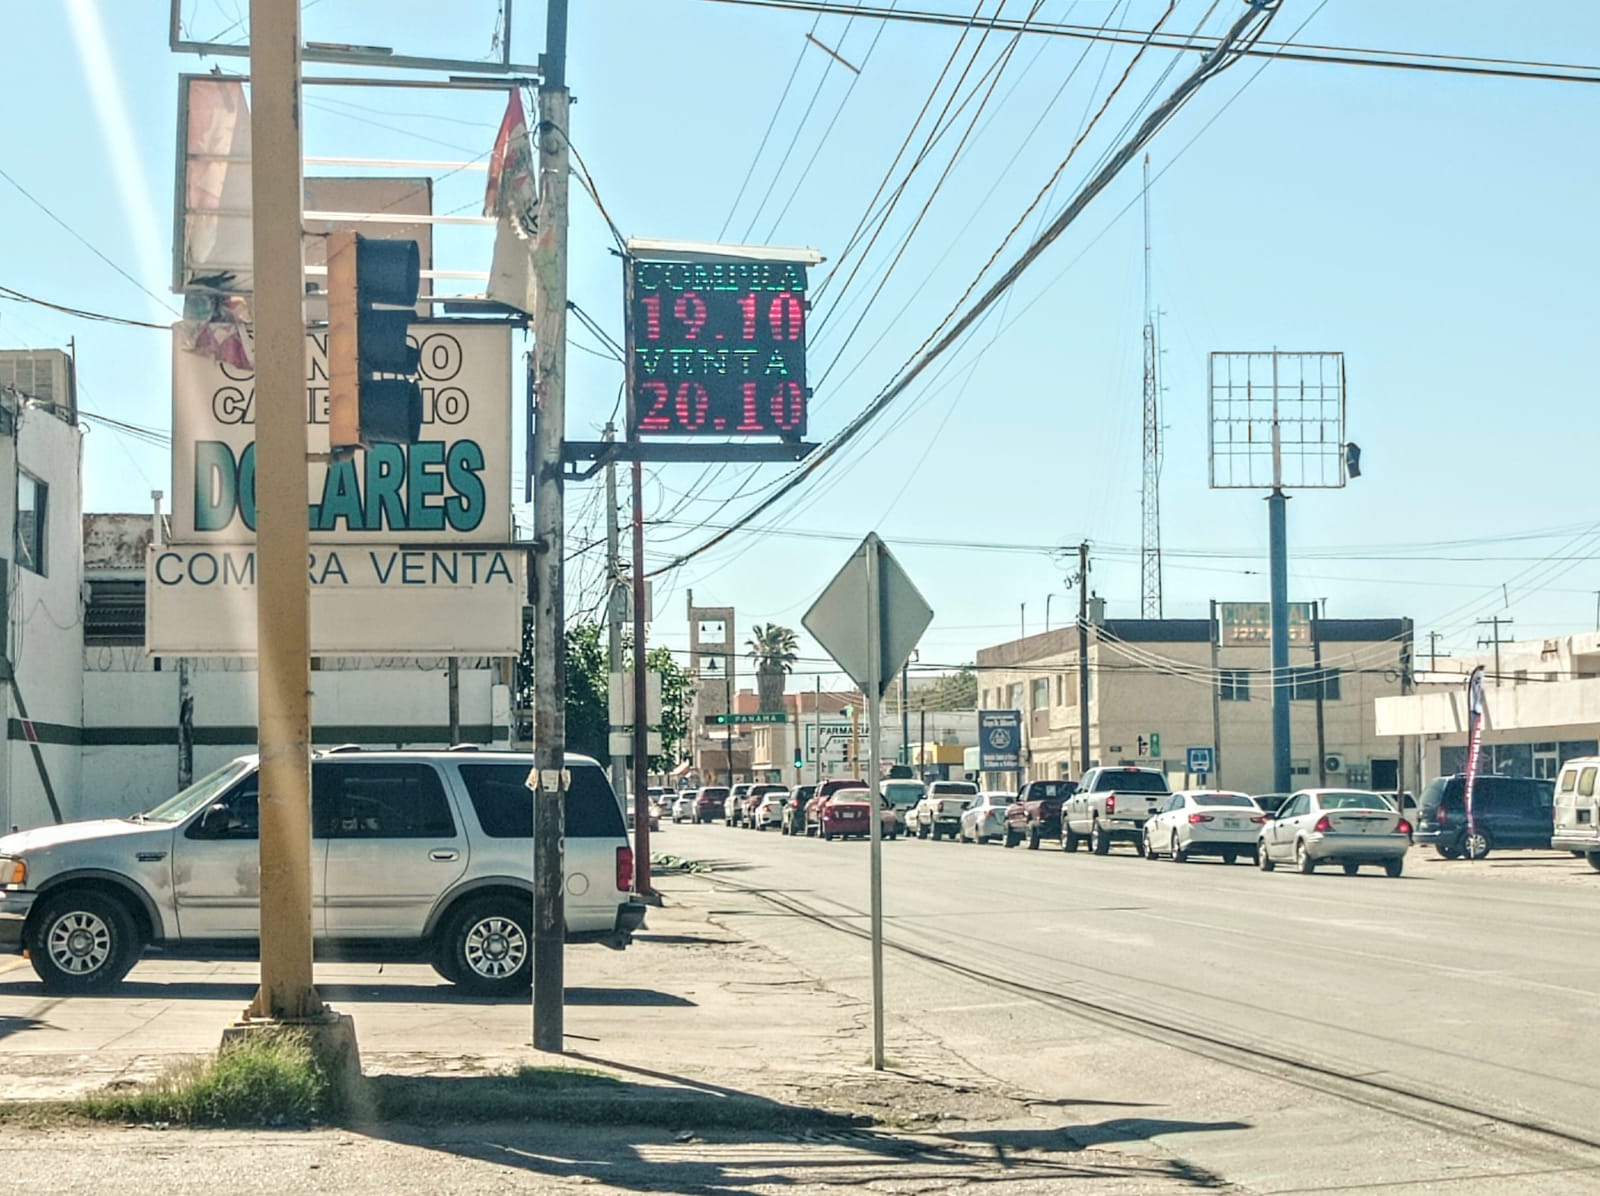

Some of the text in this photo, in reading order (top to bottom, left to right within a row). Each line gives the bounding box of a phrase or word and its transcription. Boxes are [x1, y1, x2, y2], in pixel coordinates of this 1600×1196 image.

[640, 292, 803, 340] 19.10
[637, 381, 804, 430] 20.10
[369, 551, 514, 585] VENTA
[734, 715, 778, 723] PANAMA
